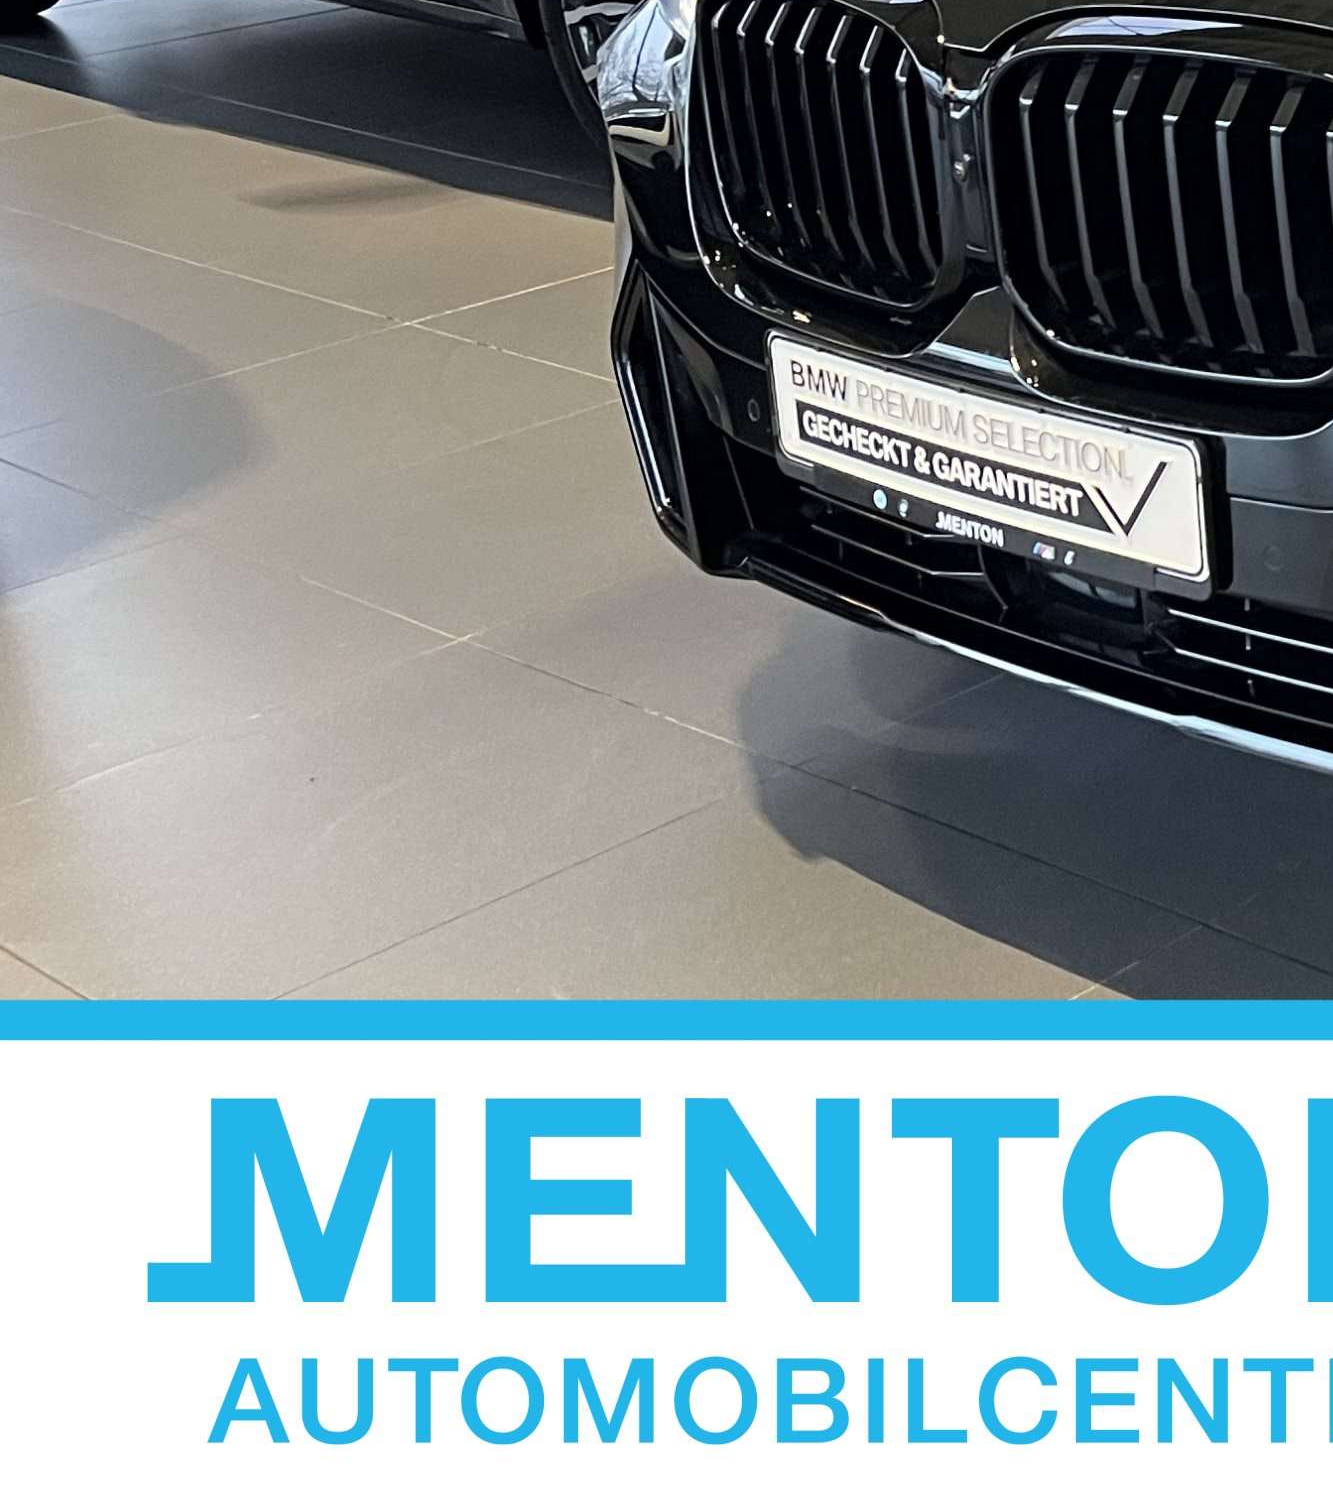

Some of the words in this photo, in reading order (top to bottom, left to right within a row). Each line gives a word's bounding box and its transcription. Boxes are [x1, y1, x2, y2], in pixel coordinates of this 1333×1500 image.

[790, 359, 848, 401] BMW
[856, 379, 967, 439] PREMIUM
[802, 409, 911, 469] GECHECKT
[913, 445, 932, 476] &
[932, 451, 1083, 518] GARANTIERT
[936, 511, 1004, 548] MENTON
